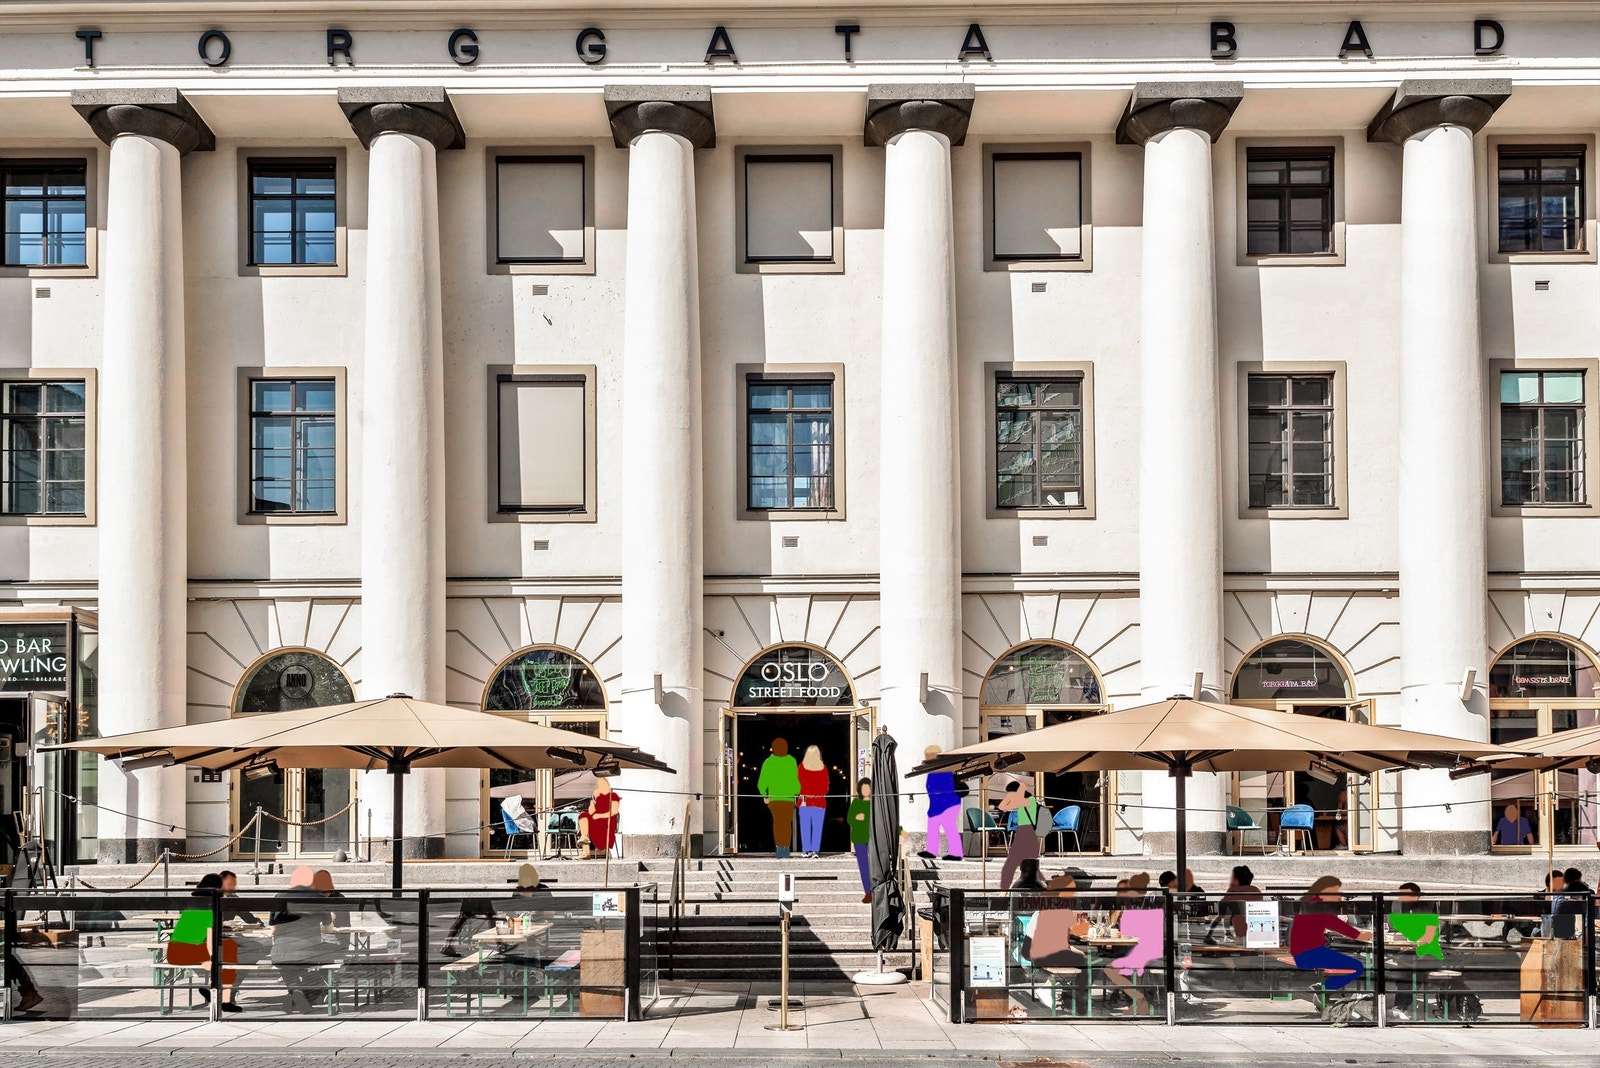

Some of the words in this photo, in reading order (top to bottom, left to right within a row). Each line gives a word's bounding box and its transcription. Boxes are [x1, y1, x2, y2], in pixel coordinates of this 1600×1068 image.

[75, 23, 993, 67] TORGGATA
[1210, 20, 1506, 59] BAD
[16, 638, 52, 653] BAR
[761, 662, 828, 682] OSLO
[1300, 680, 1317, 688] BAD
[748, 686, 796, 698] STREET
[799, 686, 841, 698] FOOD
